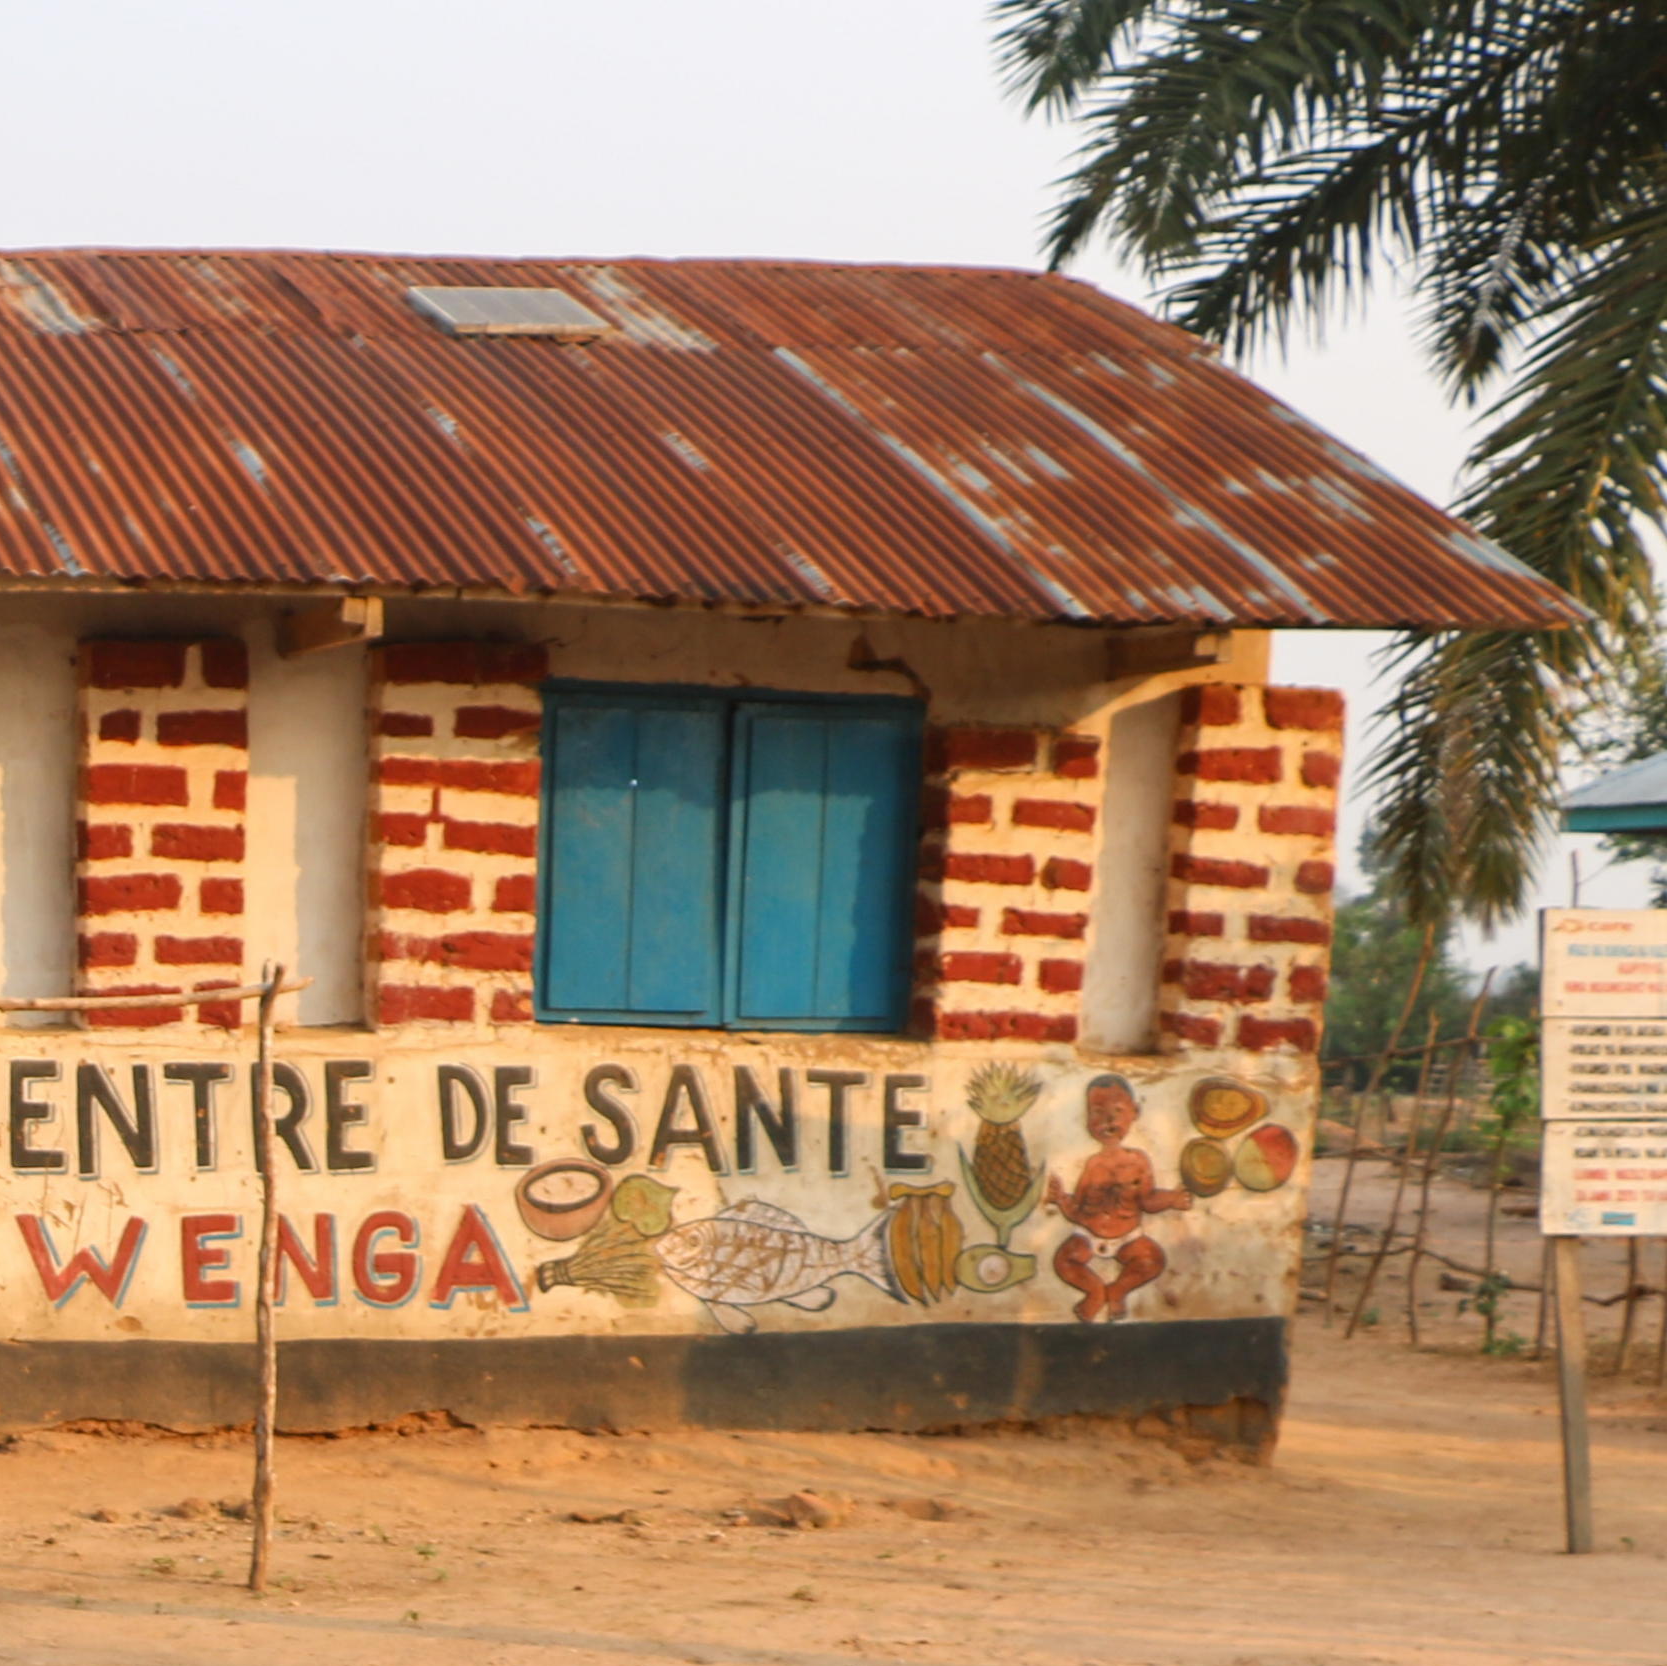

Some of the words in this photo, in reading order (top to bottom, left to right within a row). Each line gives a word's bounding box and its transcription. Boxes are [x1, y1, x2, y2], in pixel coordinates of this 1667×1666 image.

[436, 1063, 536, 1167] DE
[580, 1063, 933, 1178] SANTE
[15, 1203, 530, 1311] WENGA
